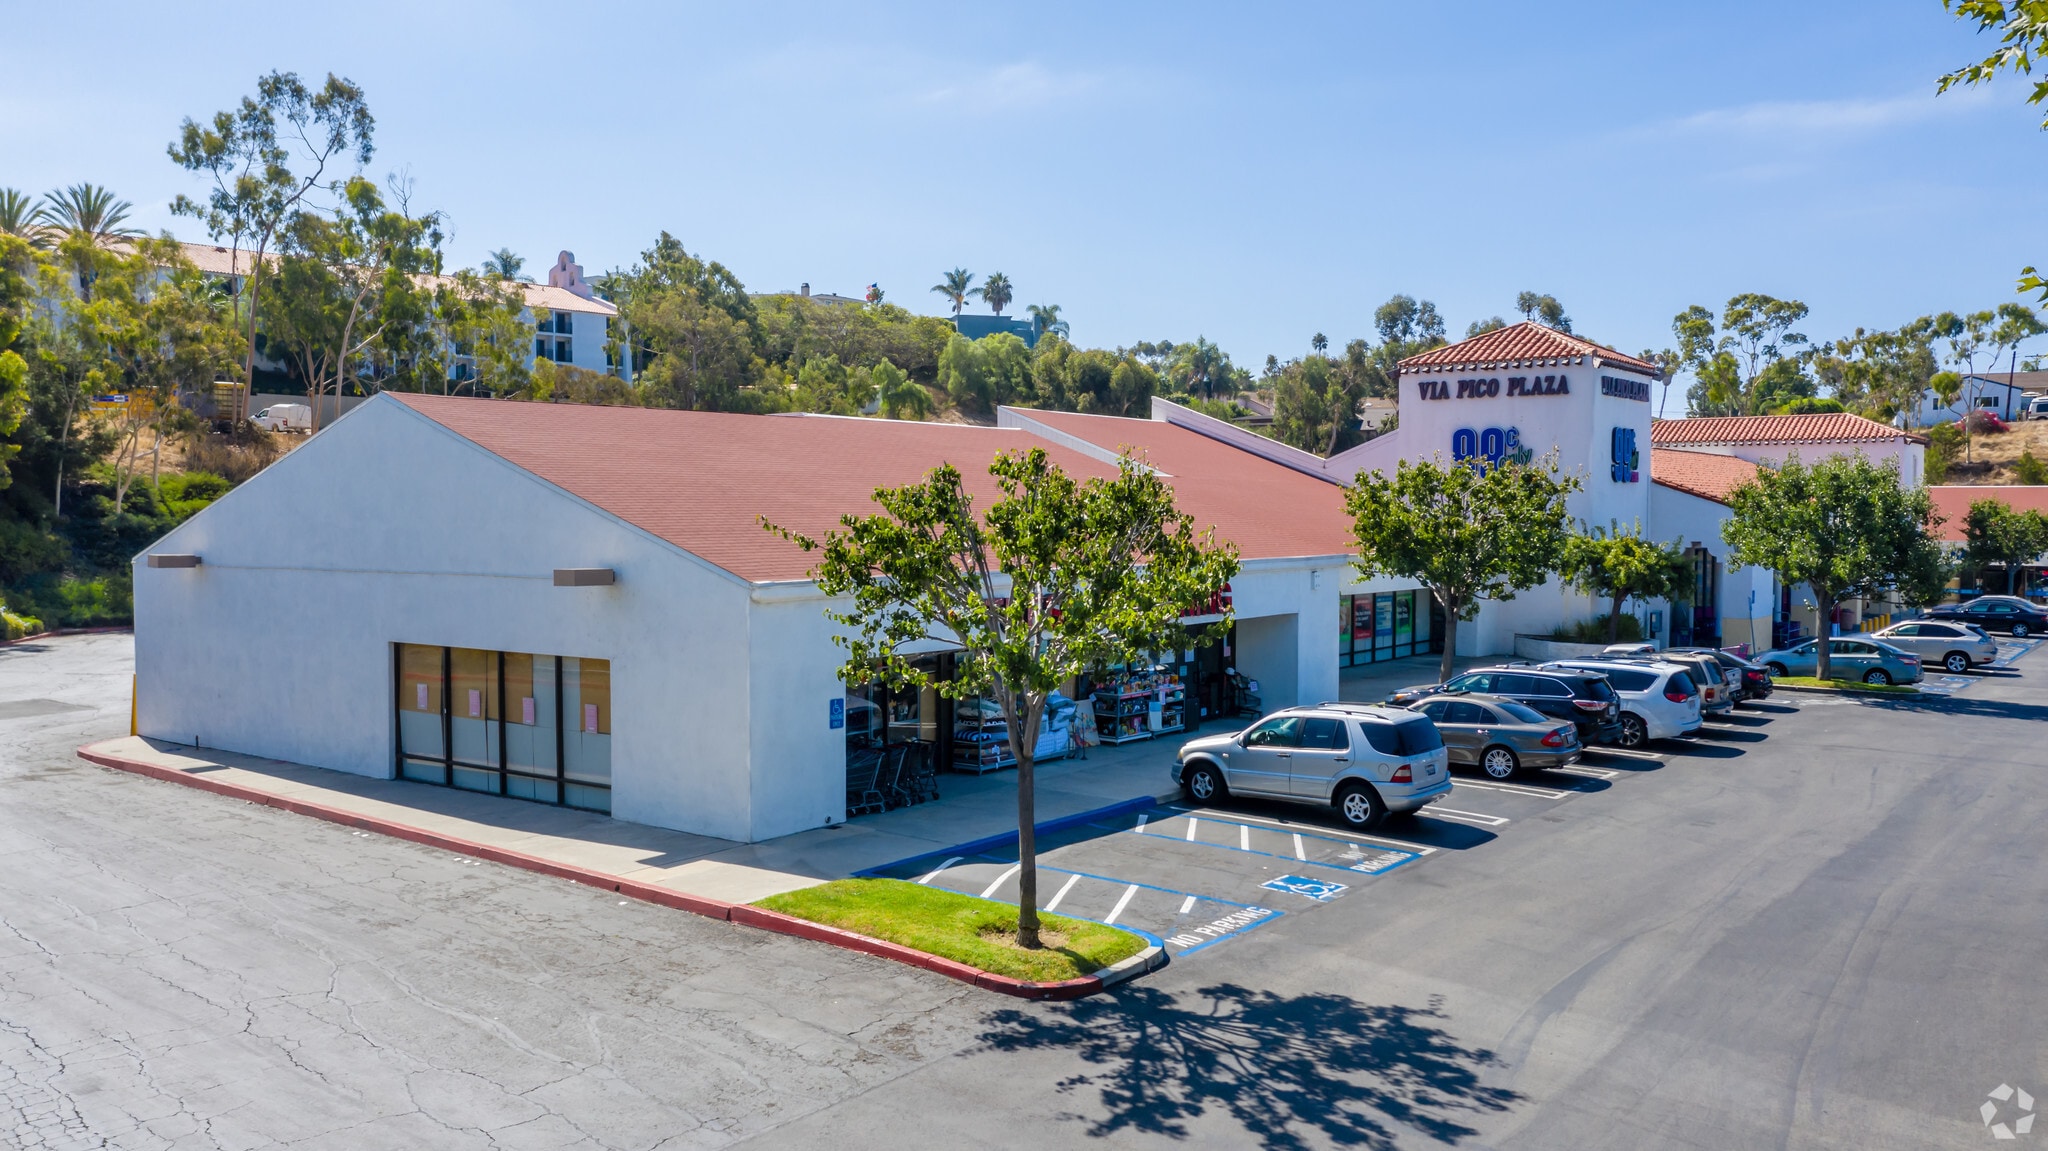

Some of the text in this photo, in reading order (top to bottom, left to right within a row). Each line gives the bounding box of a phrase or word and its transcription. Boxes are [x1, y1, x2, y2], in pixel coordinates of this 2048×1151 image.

[1418, 375, 1570, 401] VIA PICO PLAZA
[1164, 906, 1273, 948] NO PARKING
